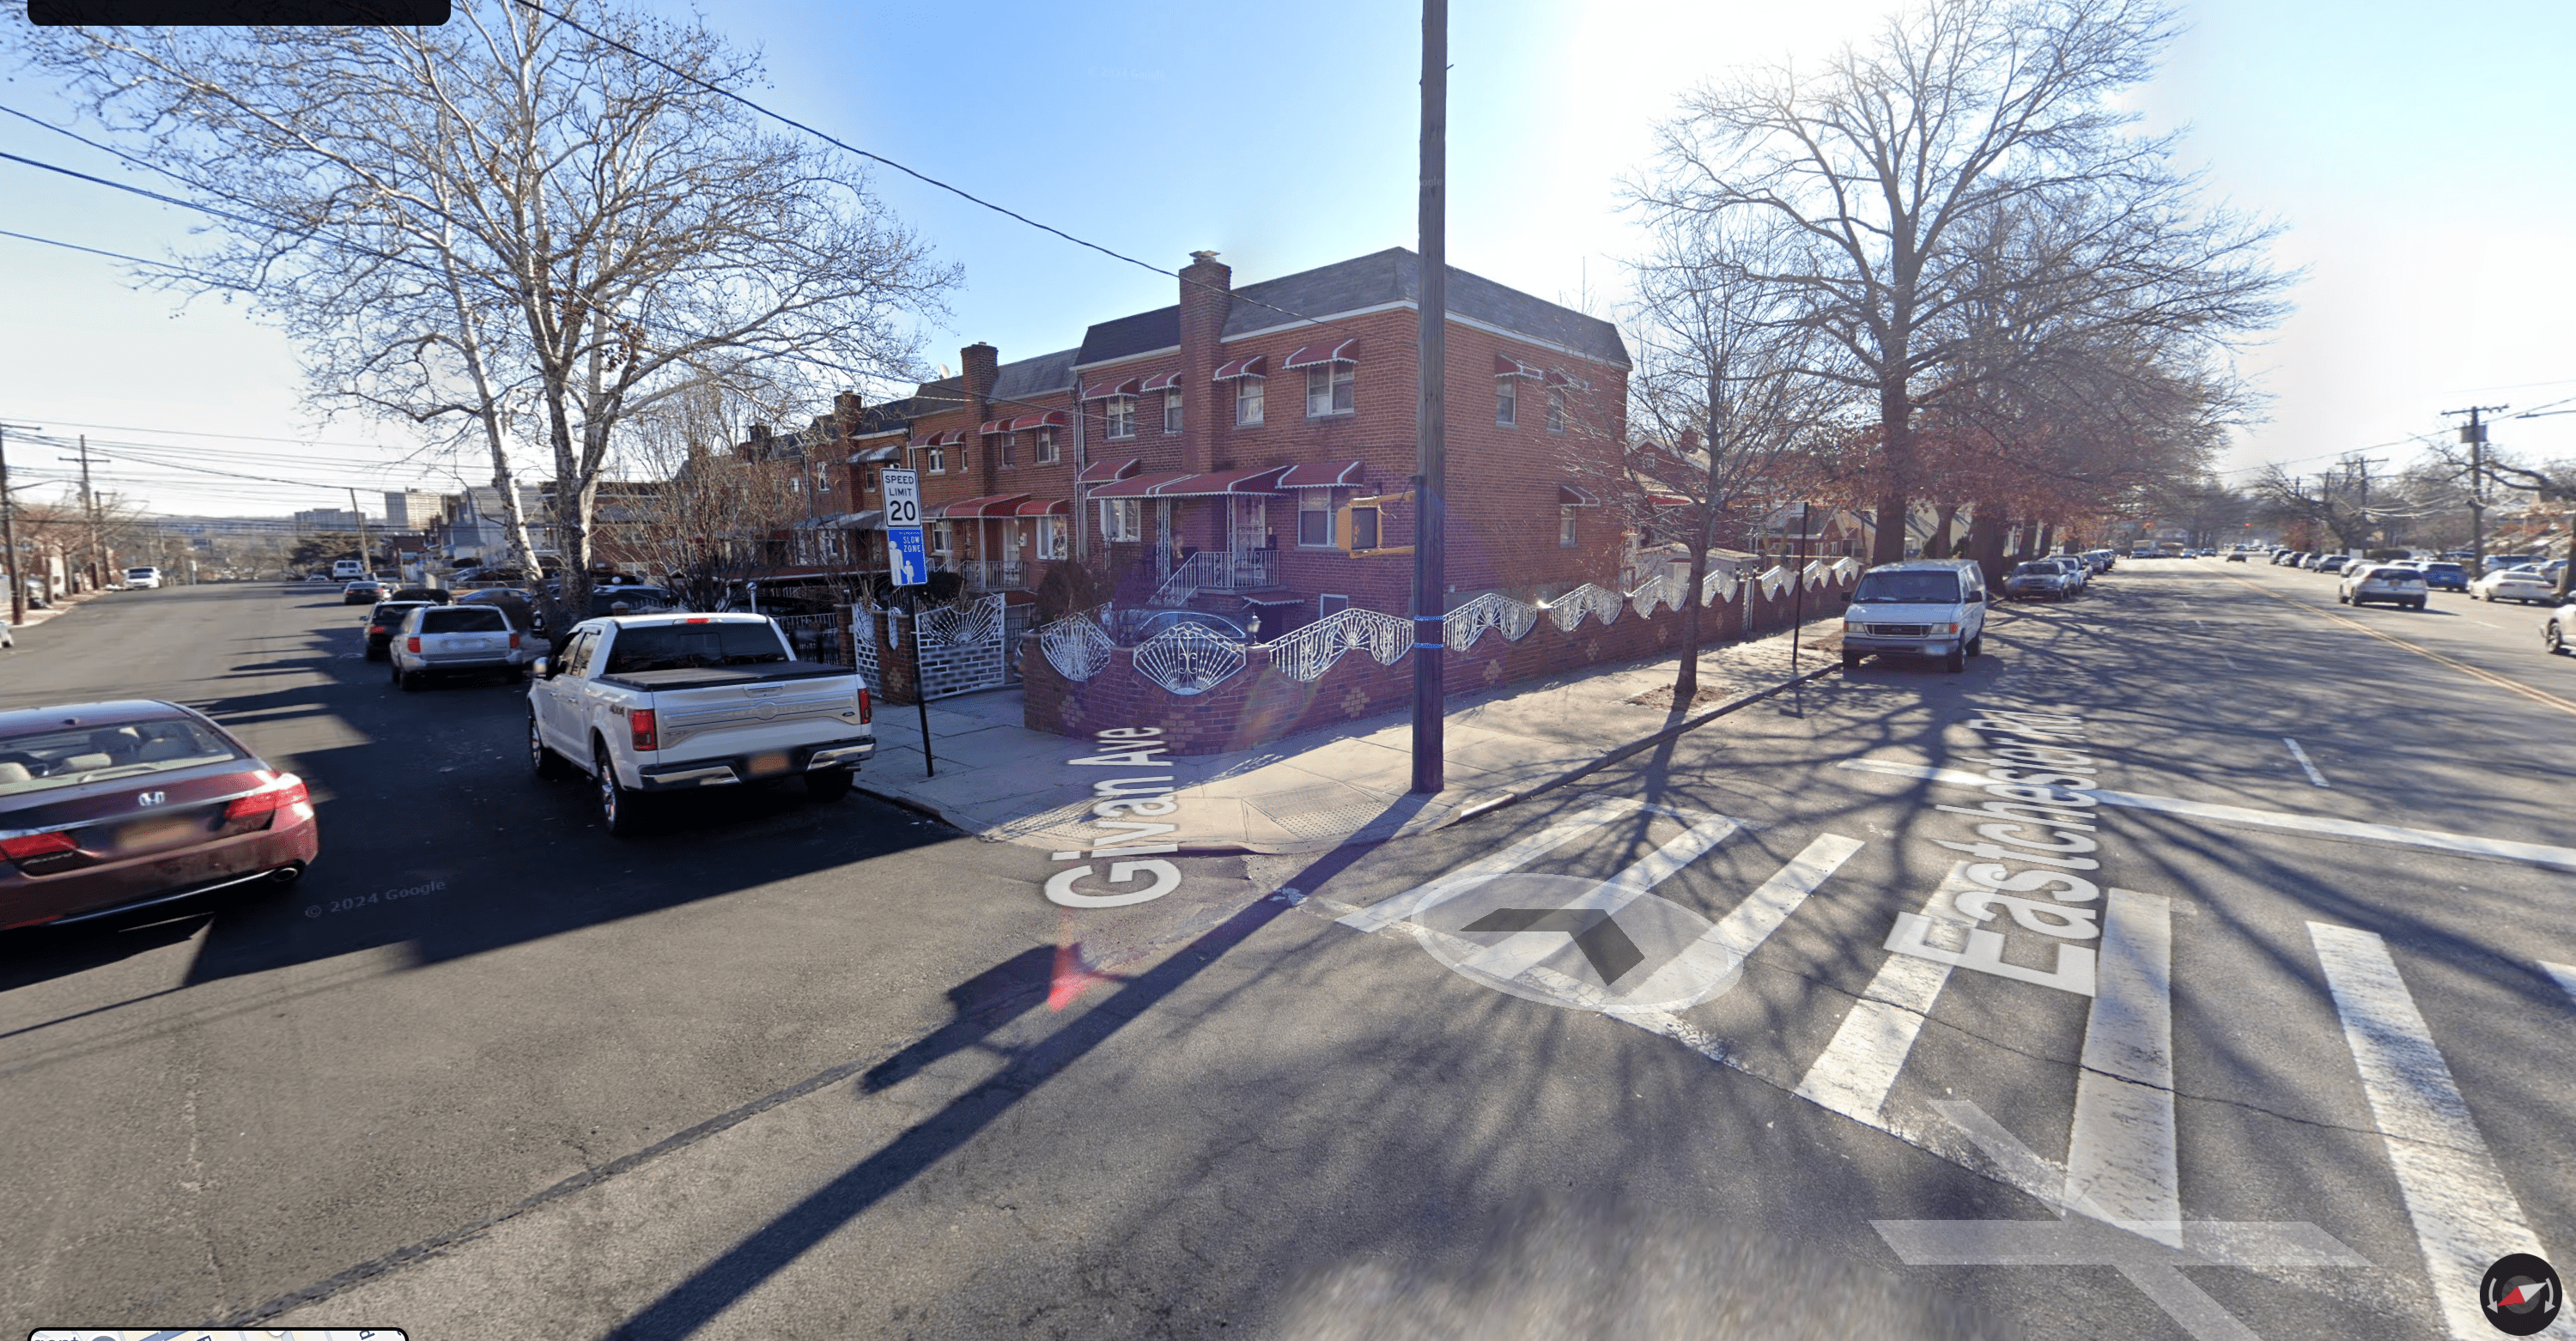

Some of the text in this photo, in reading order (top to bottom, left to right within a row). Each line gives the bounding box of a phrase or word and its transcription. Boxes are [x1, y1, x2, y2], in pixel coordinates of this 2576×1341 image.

[884, 475, 914, 484] SPEED
[889, 488, 912, 496] LIMIT
[890, 500, 916, 521] 20
[903, 536, 920, 544] SLOW
[903, 544, 921, 553] ZONE
